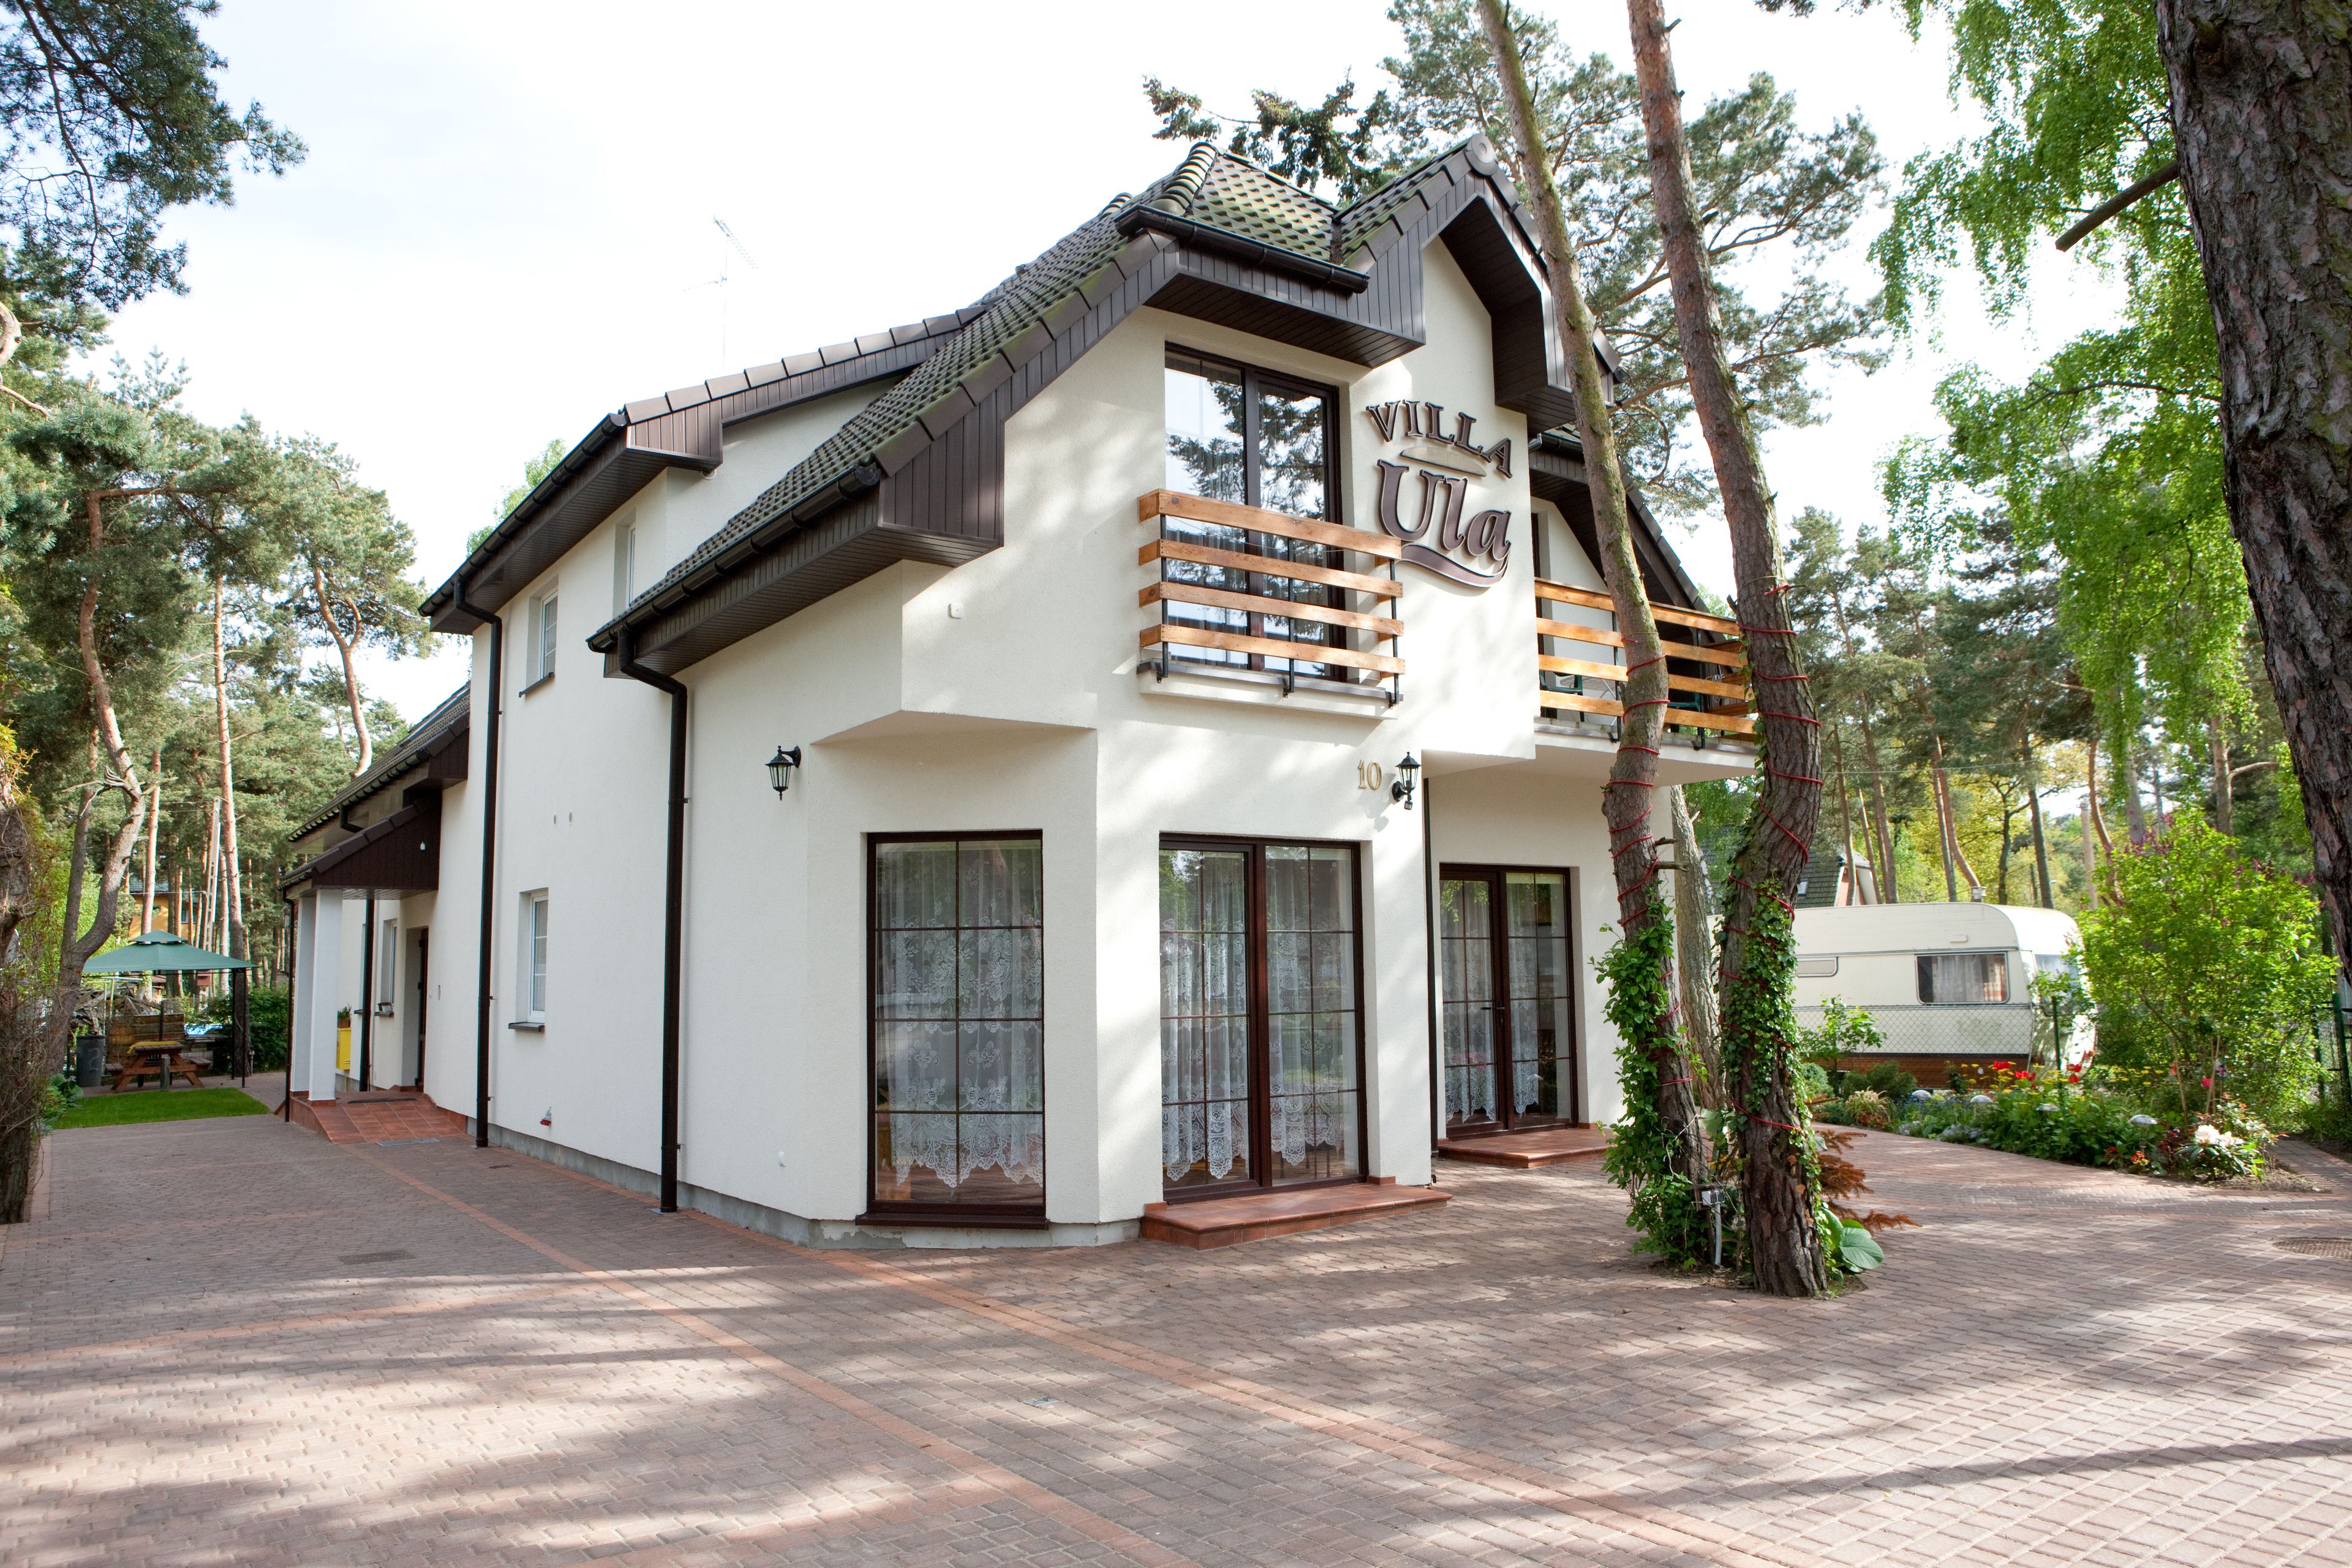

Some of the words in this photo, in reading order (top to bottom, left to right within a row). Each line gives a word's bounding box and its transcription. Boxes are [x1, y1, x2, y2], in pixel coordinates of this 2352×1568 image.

[1365, 399, 1513, 479] VILLA
[1376, 458, 1512, 561] Ula
[1357, 759, 1382, 791] 10
